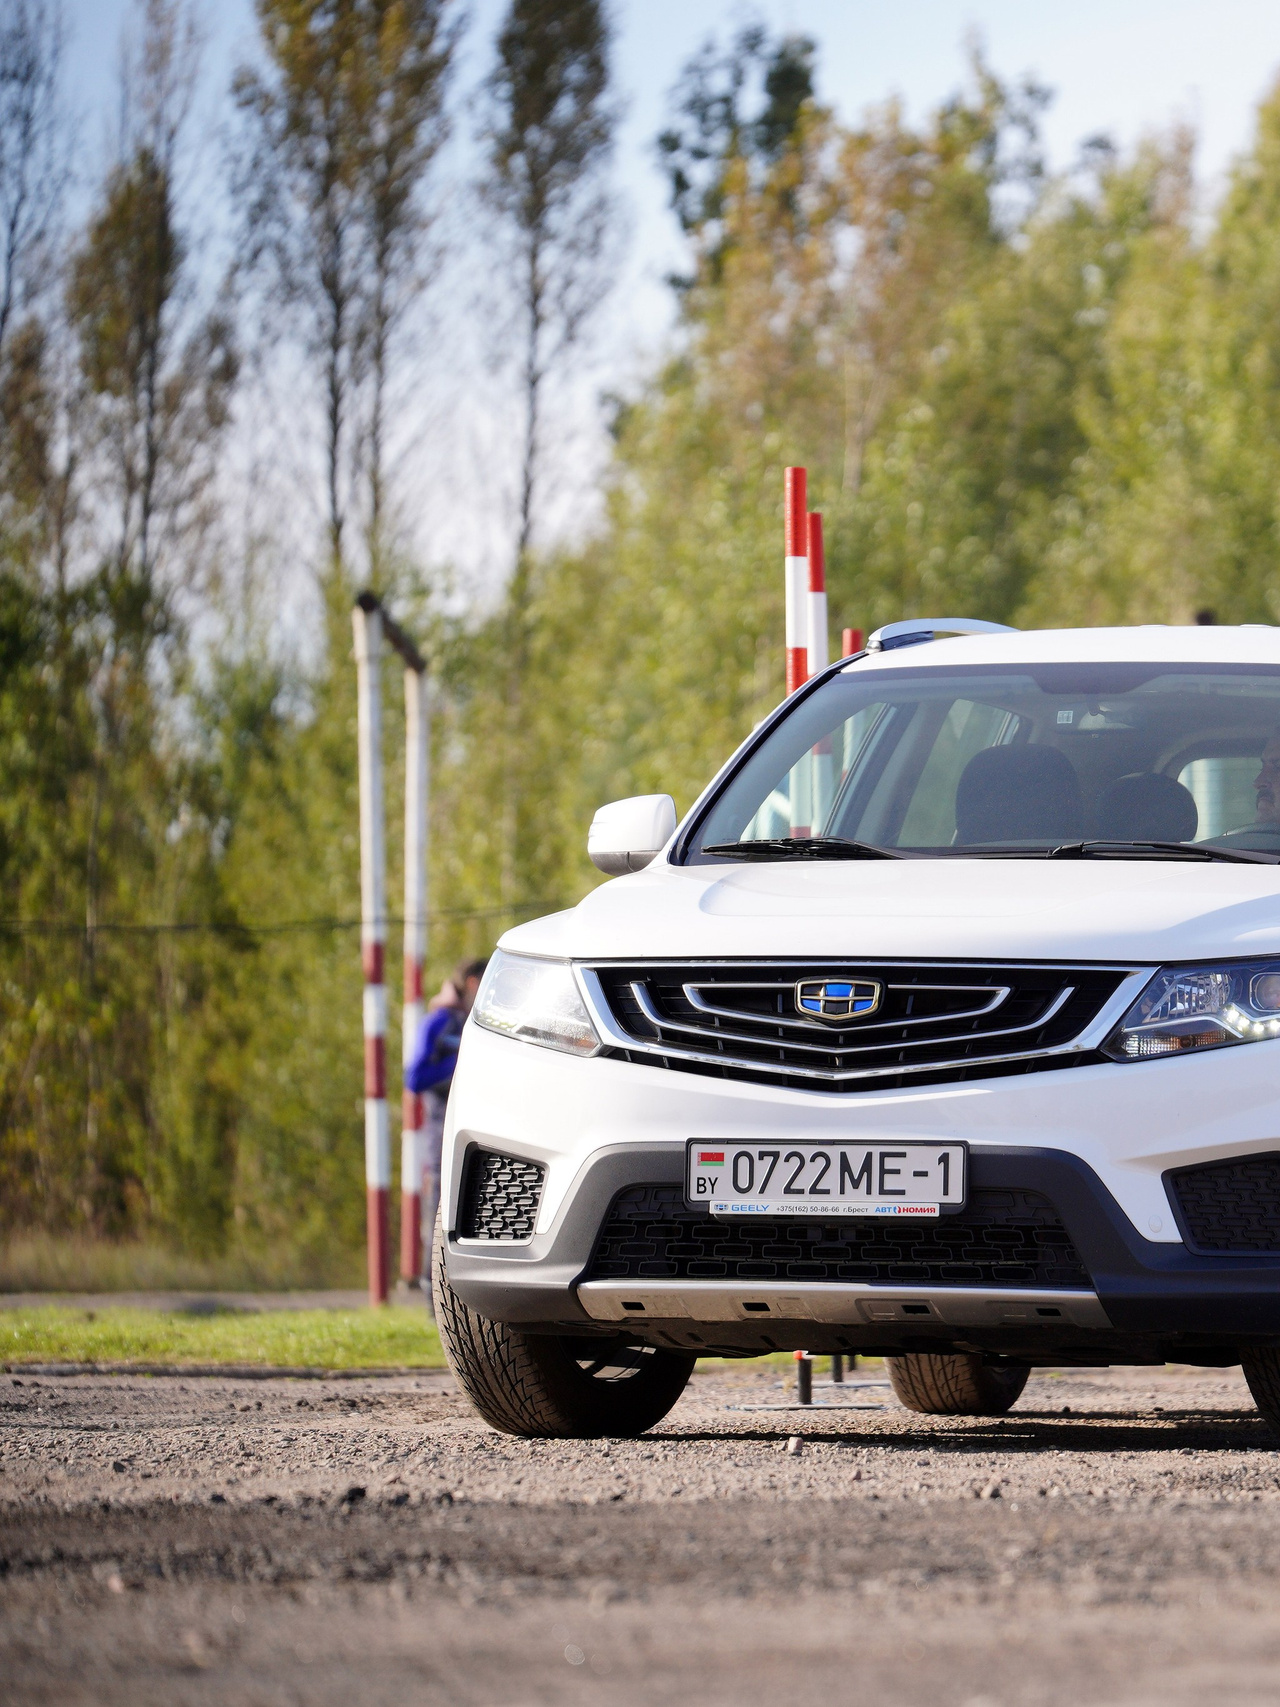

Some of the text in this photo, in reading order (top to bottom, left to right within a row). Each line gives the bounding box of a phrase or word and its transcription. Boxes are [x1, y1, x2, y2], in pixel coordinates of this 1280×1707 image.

[696, 1177, 718, 1194] BY
[731, 1204, 770, 1212] GEELY
[776, 1205, 808, 1213] +375(162)
